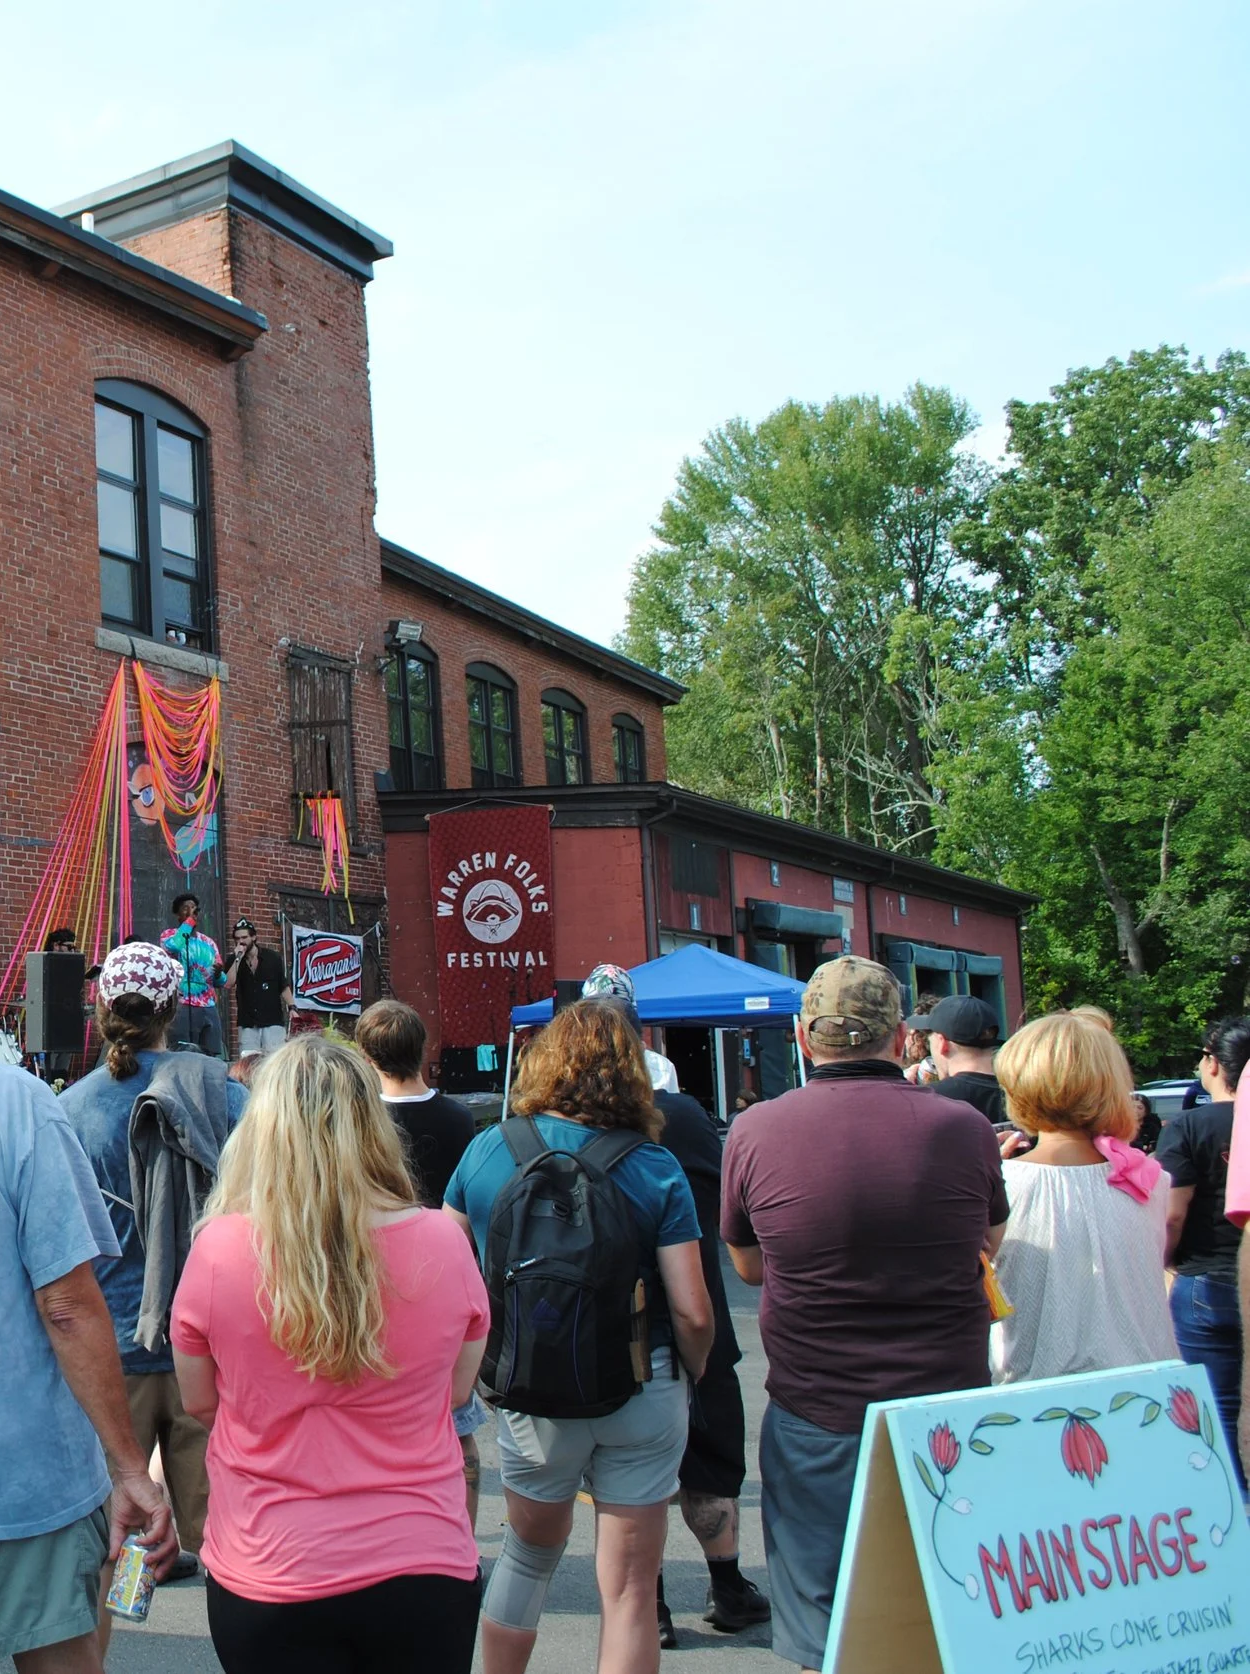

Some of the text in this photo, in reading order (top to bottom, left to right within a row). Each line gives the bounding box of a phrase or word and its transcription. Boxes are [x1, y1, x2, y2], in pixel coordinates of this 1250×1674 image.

[436, 852, 549, 917] WARREN FOLKS
[447, 951, 548, 968] FESTIVAL
[1015, 1595, 1233, 1674] SHARKS COME CRUISIN'
